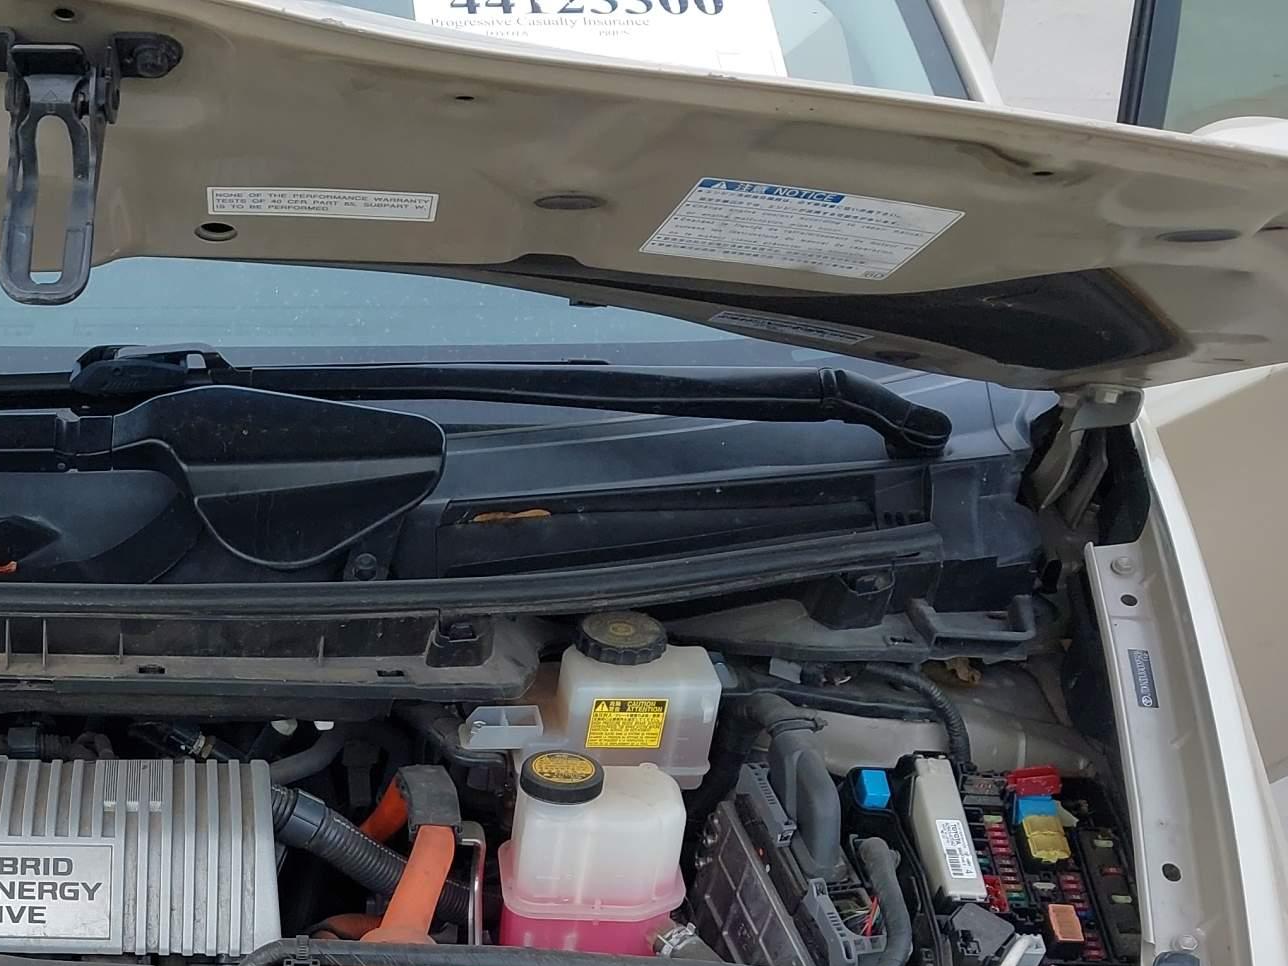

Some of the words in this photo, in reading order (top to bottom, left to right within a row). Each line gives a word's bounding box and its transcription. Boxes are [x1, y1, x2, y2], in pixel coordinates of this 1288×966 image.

[431, 17, 513, 29] Progressive
[516, 16, 578, 28] Casualty
[583, 16, 650, 26] Insurance
[293, 193, 368, 201] PERFORMANCE
[772, 186, 837, 202] NOTICE
